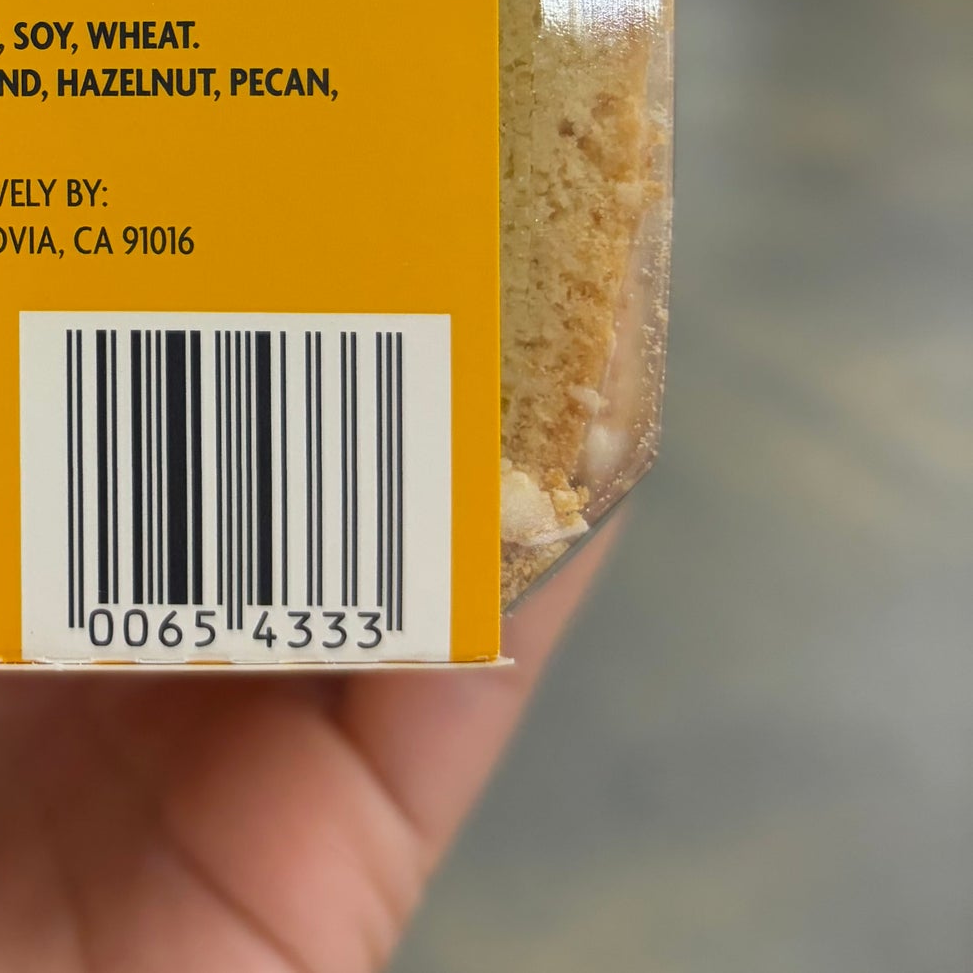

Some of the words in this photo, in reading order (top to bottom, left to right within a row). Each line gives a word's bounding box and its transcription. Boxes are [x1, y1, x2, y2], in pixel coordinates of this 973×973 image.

[14, 22, 78, 54] SOY,
[87, 21, 199, 49] WHEAT.
[58, 68, 220, 101] HAZELNUT,
[231, 68, 338, 101] PECAN,
[67, 179, 107, 207] BY:
[74, 227, 113, 254] CA
[123, 226, 194, 254] 91016
[89, 608, 217, 647] 0065
[252, 610, 383, 648] 4333
